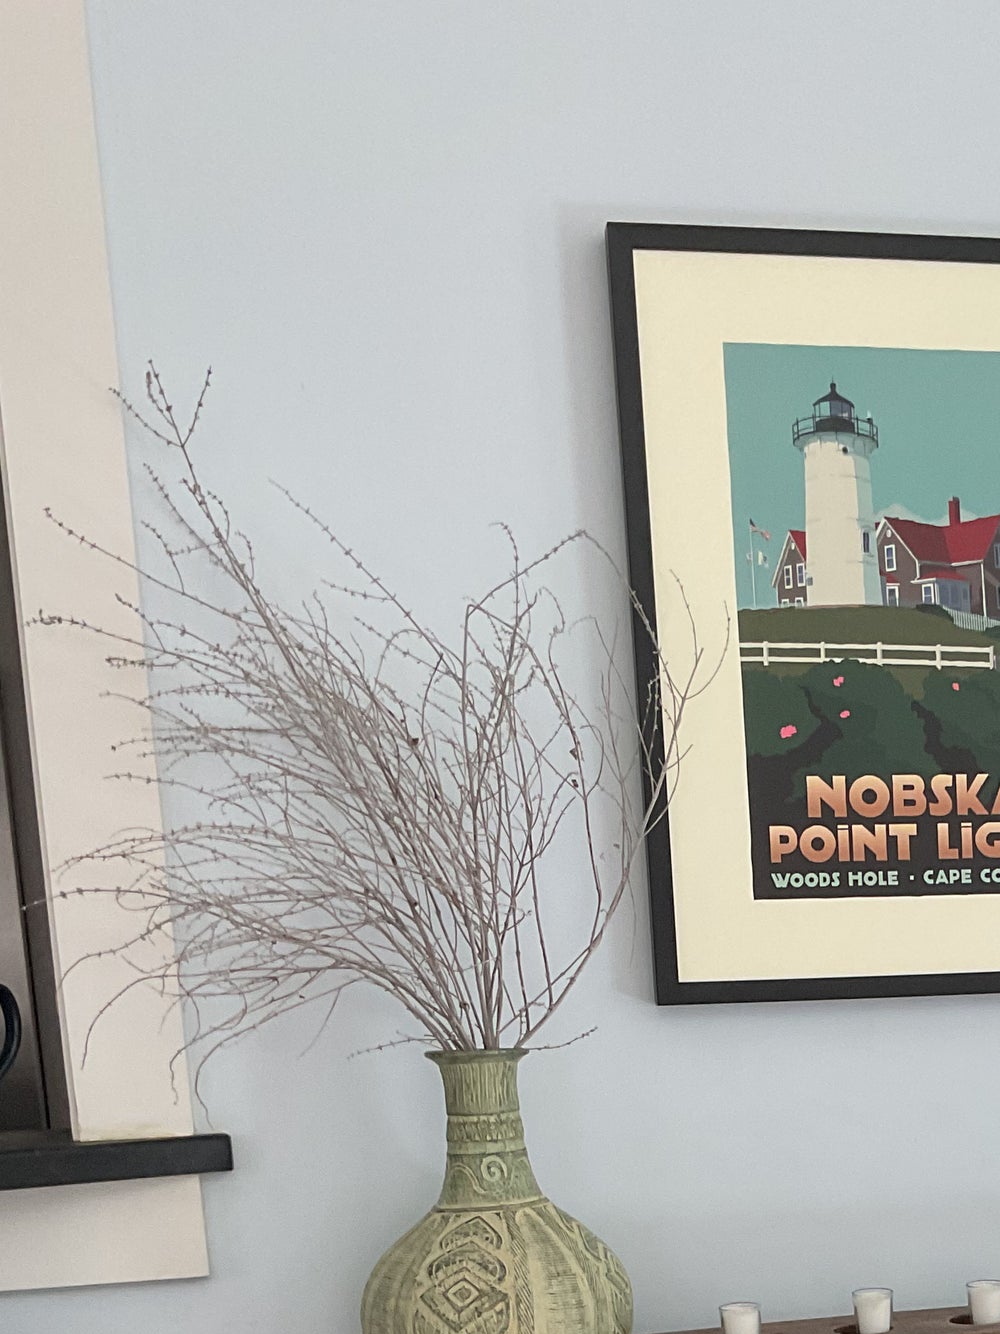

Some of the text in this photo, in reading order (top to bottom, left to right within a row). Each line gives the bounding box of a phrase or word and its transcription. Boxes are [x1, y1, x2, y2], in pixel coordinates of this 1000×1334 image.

[770, 872, 840, 888] WOODS
[848, 871, 899, 886] HOLE
[923, 869, 972, 885] CAPE
